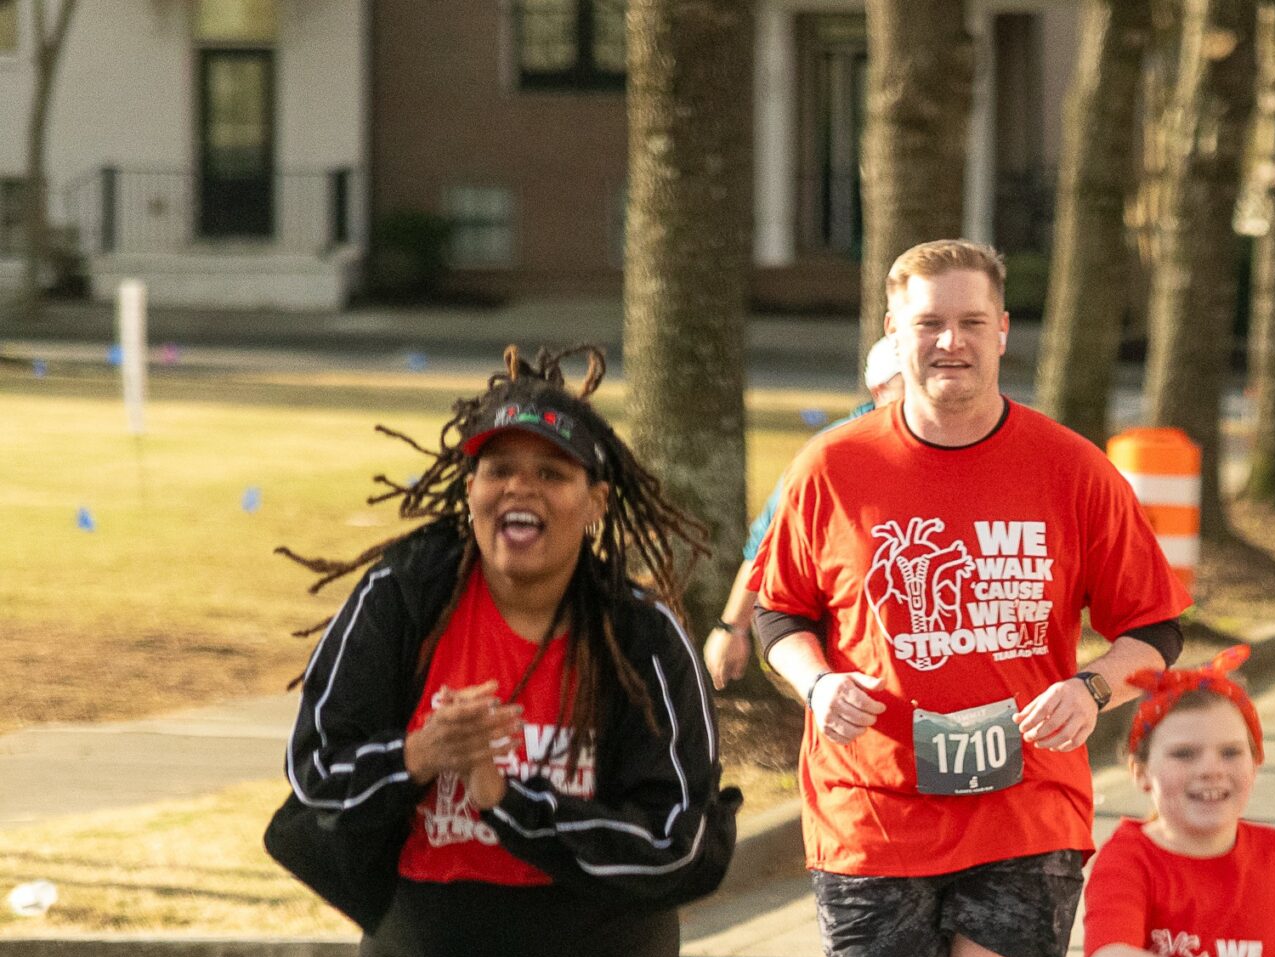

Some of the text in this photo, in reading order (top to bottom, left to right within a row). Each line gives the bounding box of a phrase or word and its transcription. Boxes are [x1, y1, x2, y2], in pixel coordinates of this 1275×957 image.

[974, 521, 1048, 556] WE
[975, 557, 1054, 581] WALK
[966, 599, 1053, 627] WE'RE
[893, 623, 1019, 660] STRONG
[932, 725, 1007, 774] 1710
